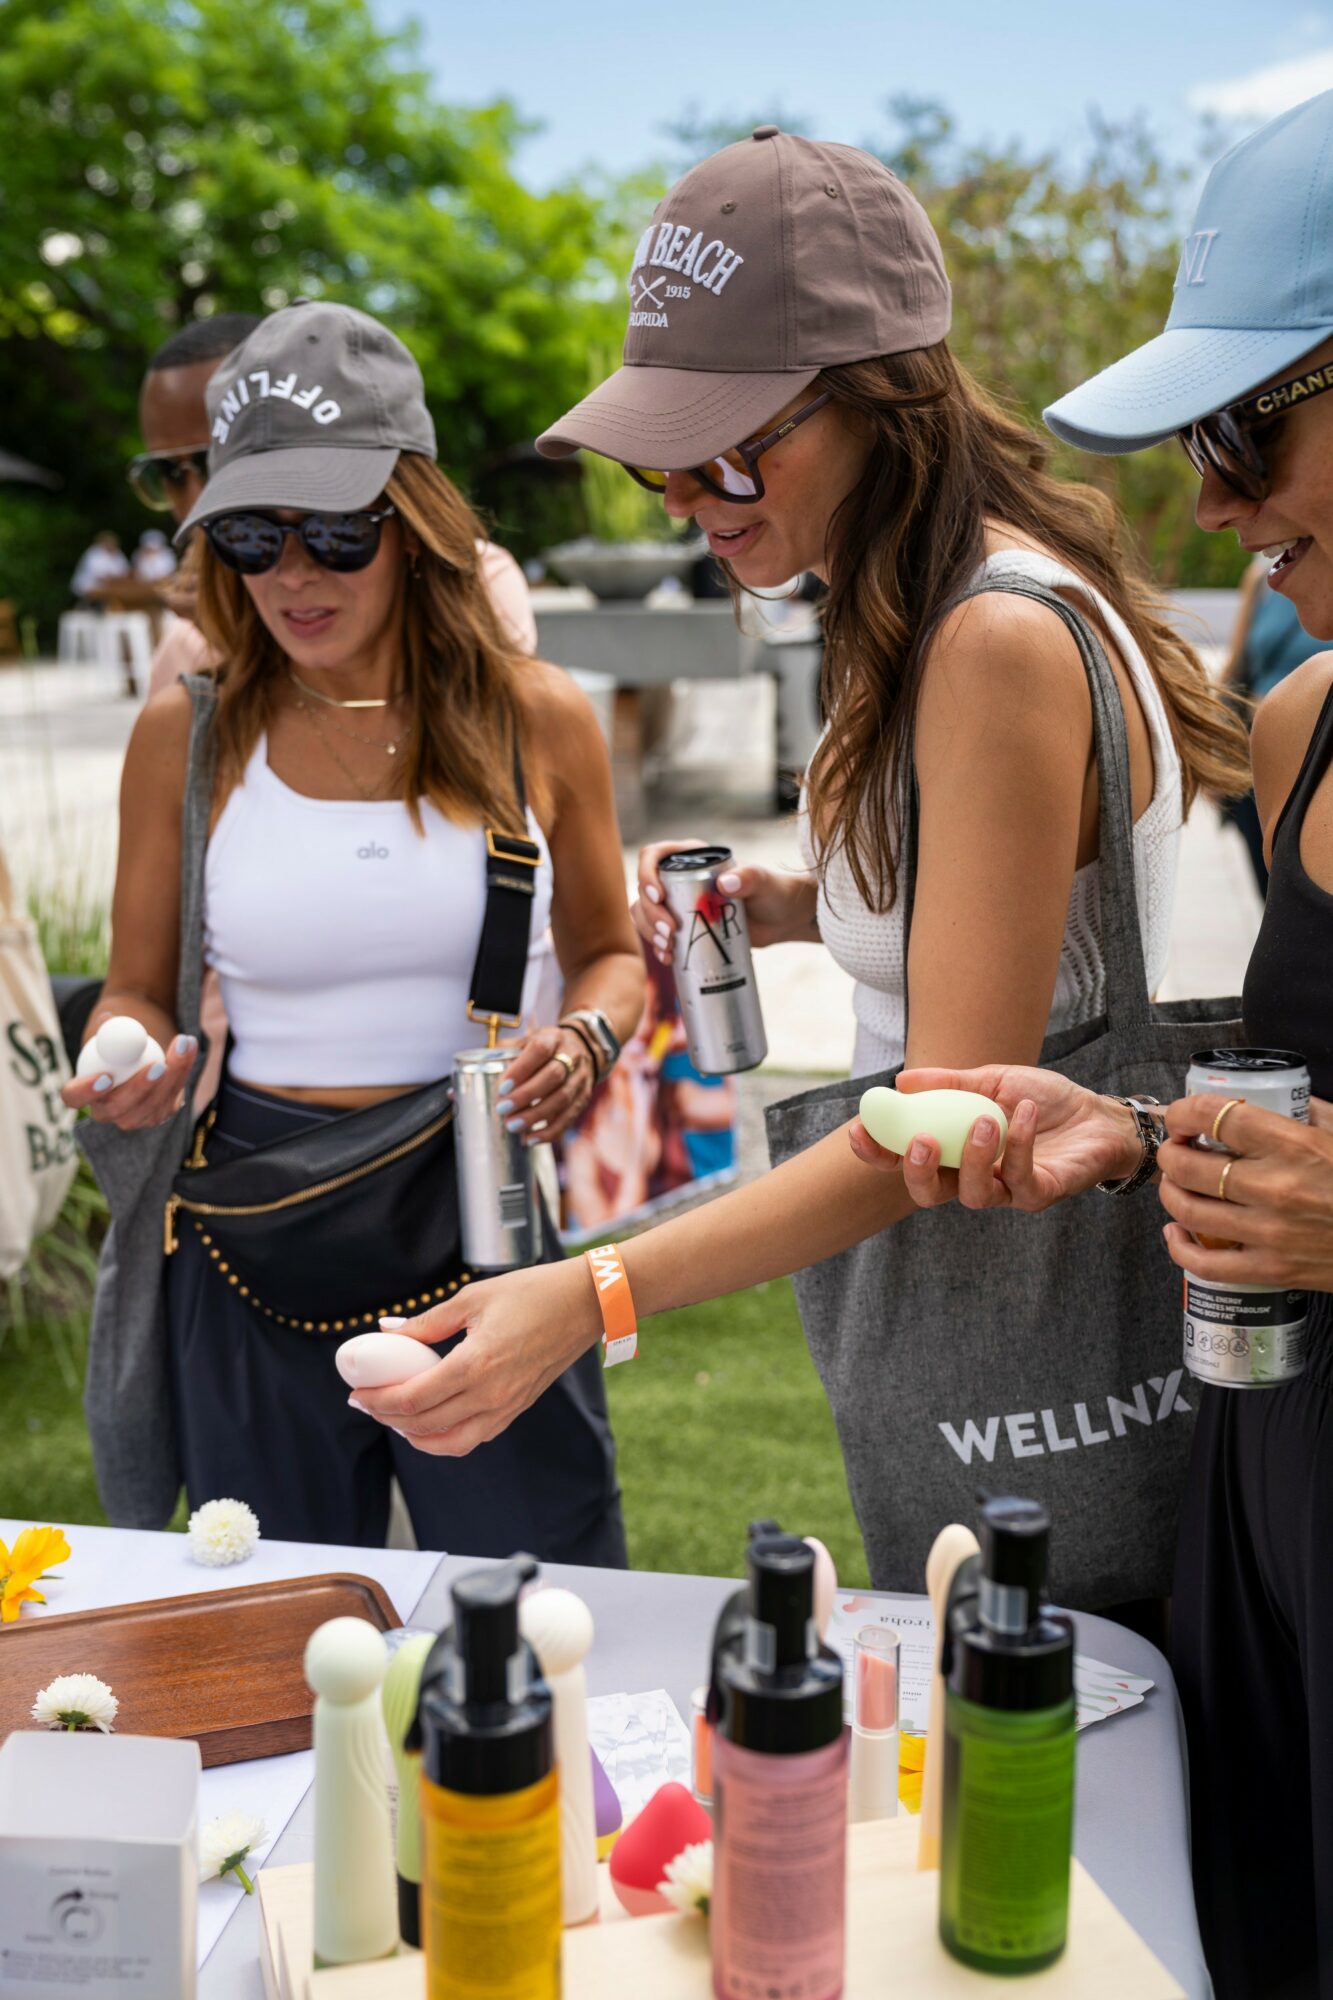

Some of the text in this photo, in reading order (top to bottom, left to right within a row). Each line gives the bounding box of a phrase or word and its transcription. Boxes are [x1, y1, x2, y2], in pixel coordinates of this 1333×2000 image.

[650, 223, 744, 296] BEACH
[664, 285, 691, 299] 1915
[212, 370, 341, 445] OFFLINE
[357, 841, 389, 859] alo
[938, 1369, 1192, 1464] WELLNX
[879, 1616, 931, 1630] iroha
